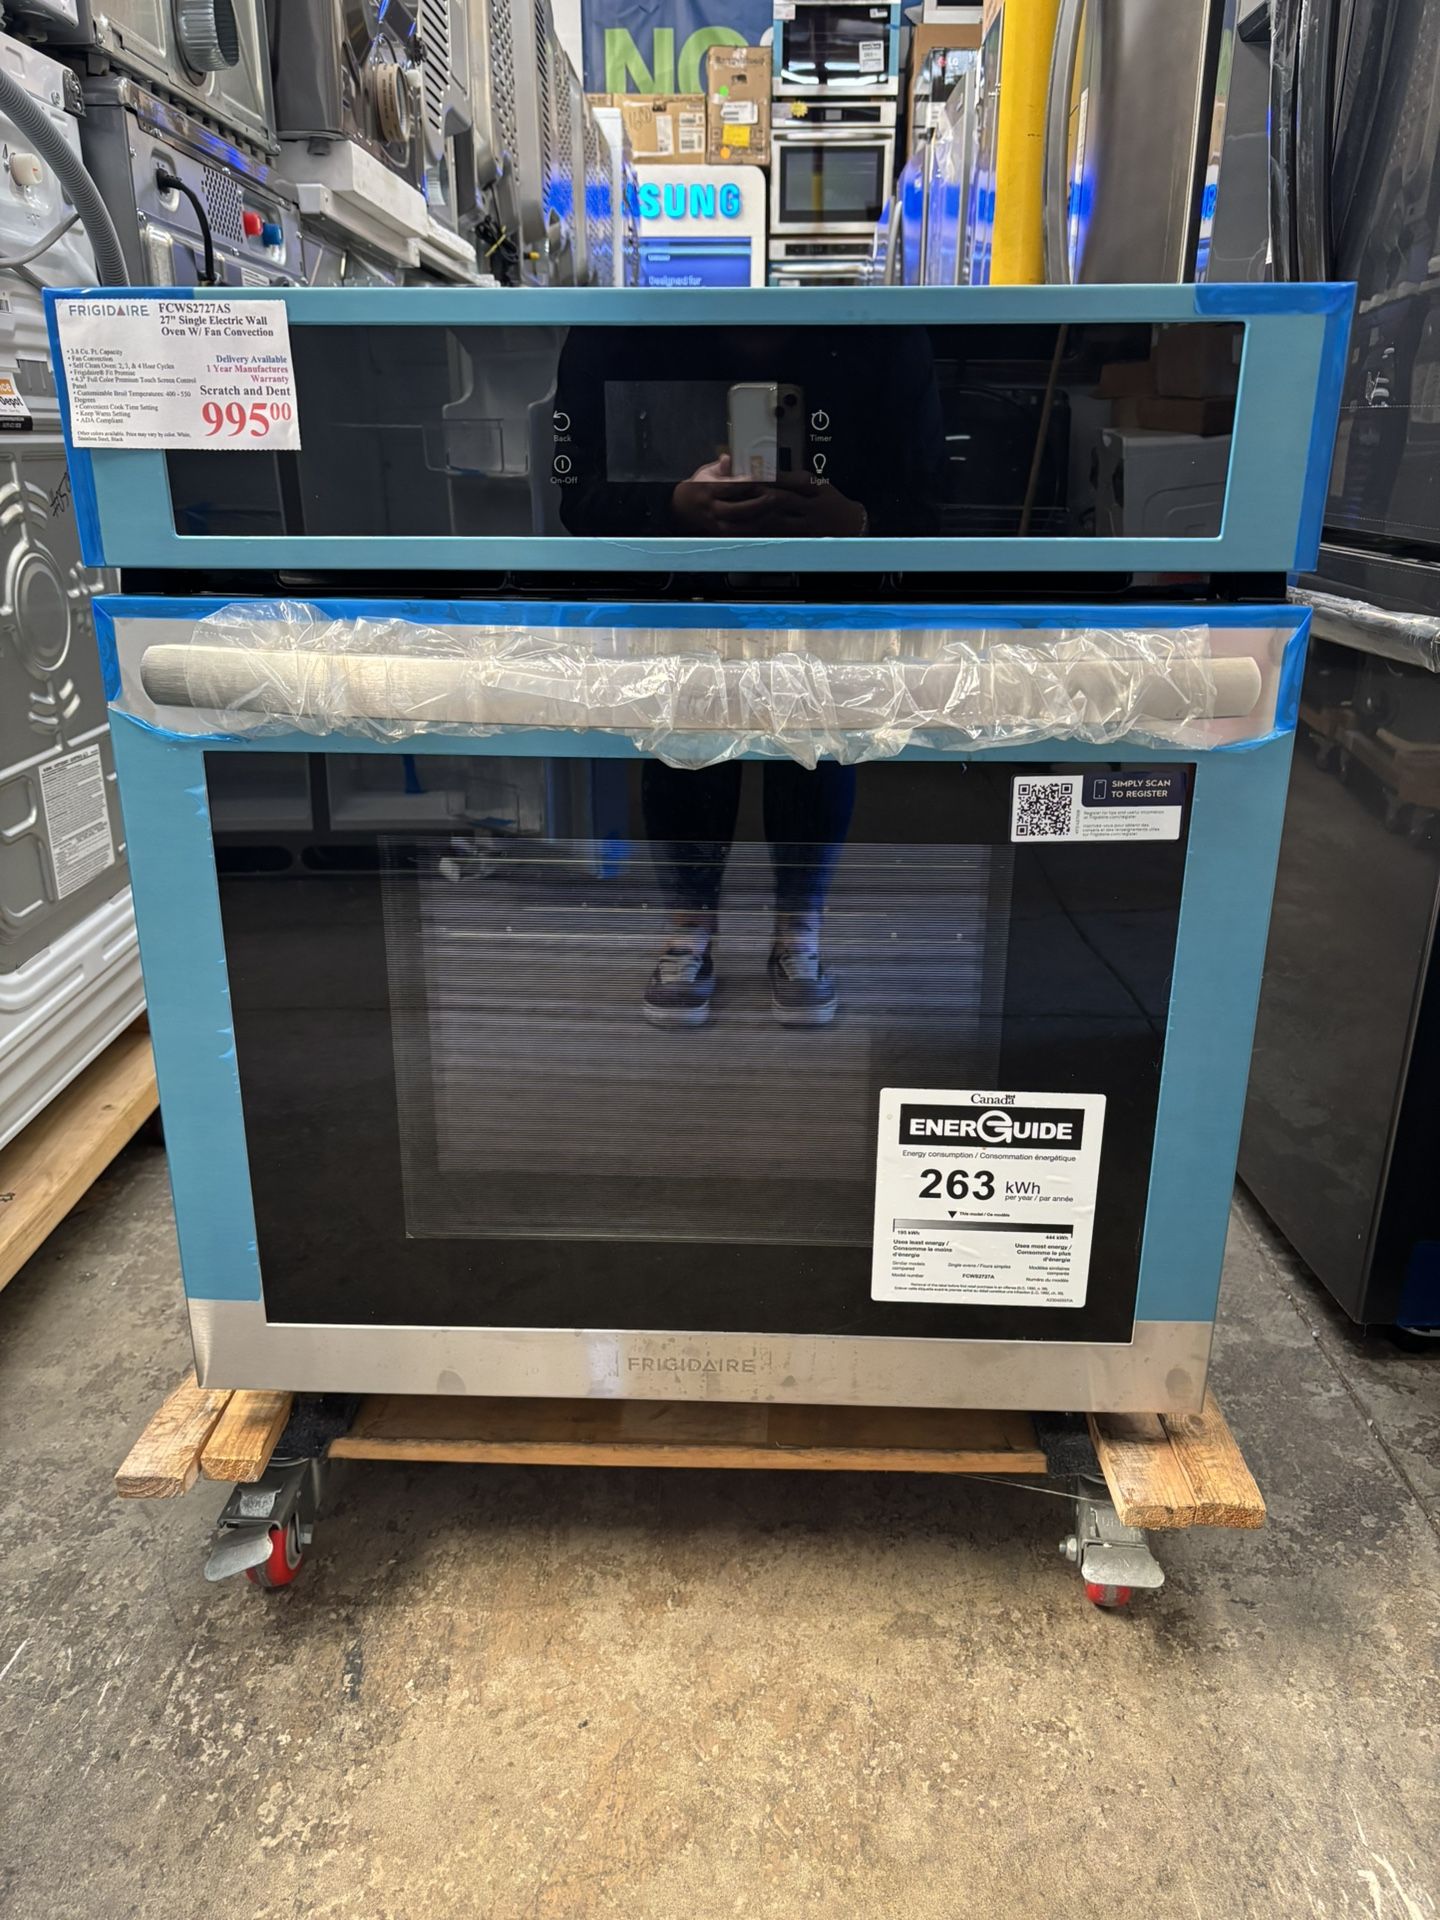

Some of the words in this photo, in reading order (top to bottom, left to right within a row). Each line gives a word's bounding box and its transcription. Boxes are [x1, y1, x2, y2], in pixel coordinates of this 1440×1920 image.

[69, 305, 149, 316] FRIGIDAIRE
[159, 303, 231, 313] FCWS2727AS
[160, 315, 176, 325] 27"
[179, 316, 207, 326] Single
[209, 316, 243, 326] Electric
[246, 316, 268, 326] Wall
[161, 327, 186, 336] Oven
[188, 327, 202, 336] W/
[204, 327, 222, 337] Fan
[224, 328, 274, 337] Convection
[216, 355, 248, 364] Delivery
[207, 365, 211, 373] 1
[213, 365, 232, 373] Year
[235, 365, 288, 373] Manufactures
[251, 375, 289, 384] Warranty
[200, 385, 240, 396] Scratch
[244, 386, 263, 396] and
[266, 386, 291, 396] Dent
[553, 434, 572, 442] Back
[810, 434, 833, 442] Timer
[550, 476, 578, 485] On-Off
[810, 476, 830, 486] Light
[1111, 780, 1144, 788] SIMPLY
[1145, 779, 1171, 787] SCAN
[1126, 790, 1168, 798] REGISTER
[971, 1093, 1015, 1105] Canada
[909, 1109, 1073, 1144] ENERGUIDE
[902, 1150, 927, 1158] Energy
[928, 1151, 974, 1159] consumption
[980, 1152, 1033, 1160] Consommation
[1034, 1154, 1077, 1162] énergétique
[919, 1168, 995, 1201] 263
[1005, 1181, 1041, 1194] kWh
[628, 1357, 756, 1373] FRIGIDAIRE
